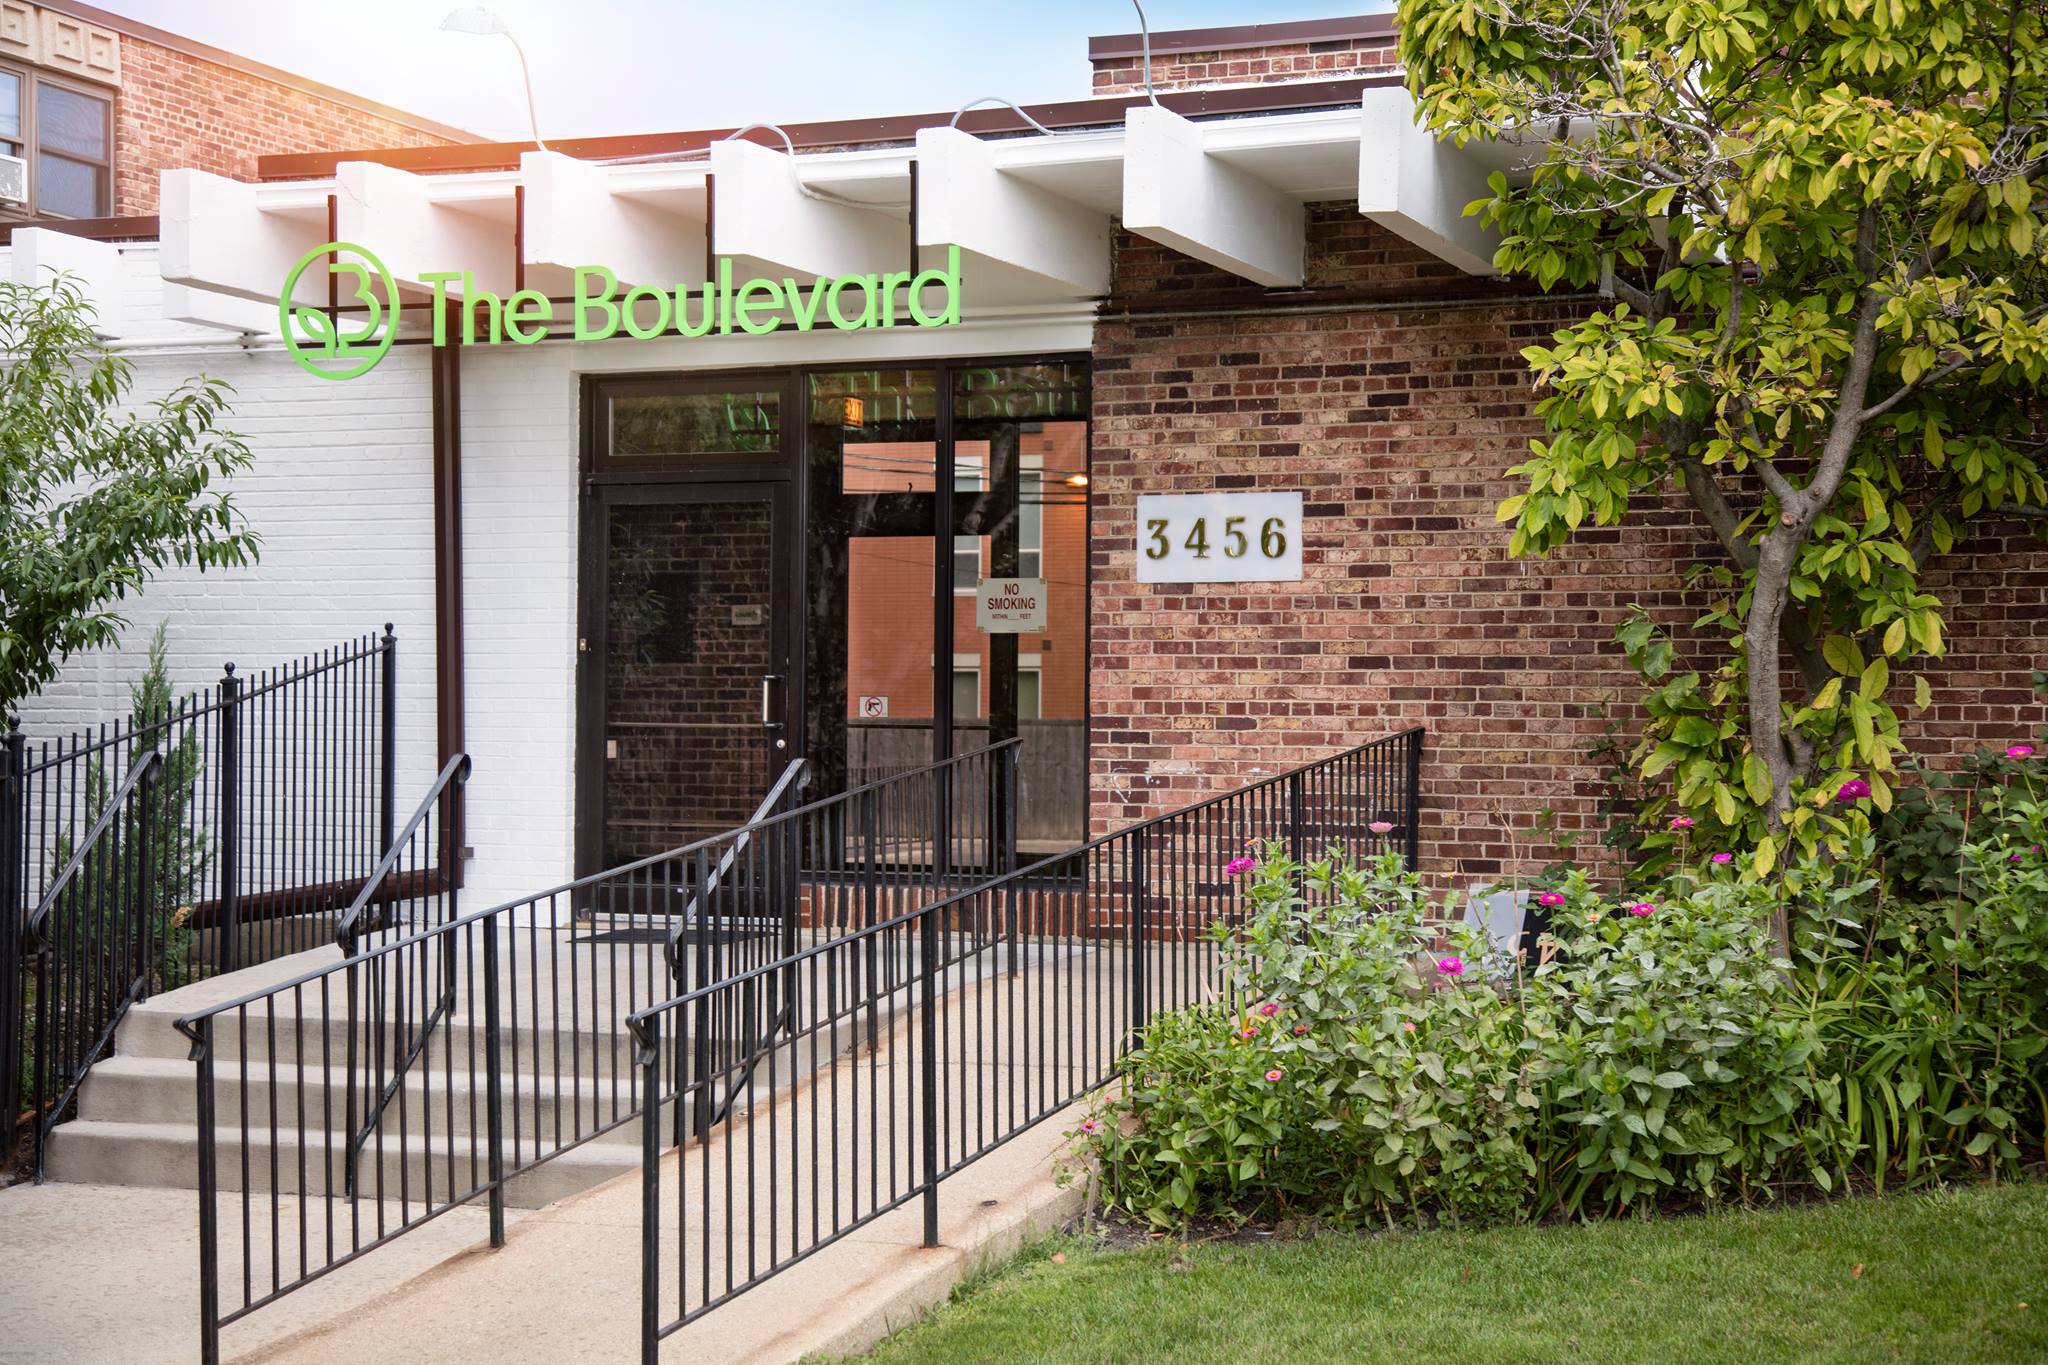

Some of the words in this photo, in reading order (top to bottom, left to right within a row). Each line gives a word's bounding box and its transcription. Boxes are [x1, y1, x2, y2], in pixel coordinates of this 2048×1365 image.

[418, 270, 552, 346] The
[574, 246, 961, 341] Boulevard
[1146, 516, 1287, 559] 3456
[1004, 583, 1020, 595] NO
[987, 597, 1036, 610] SMOKING
